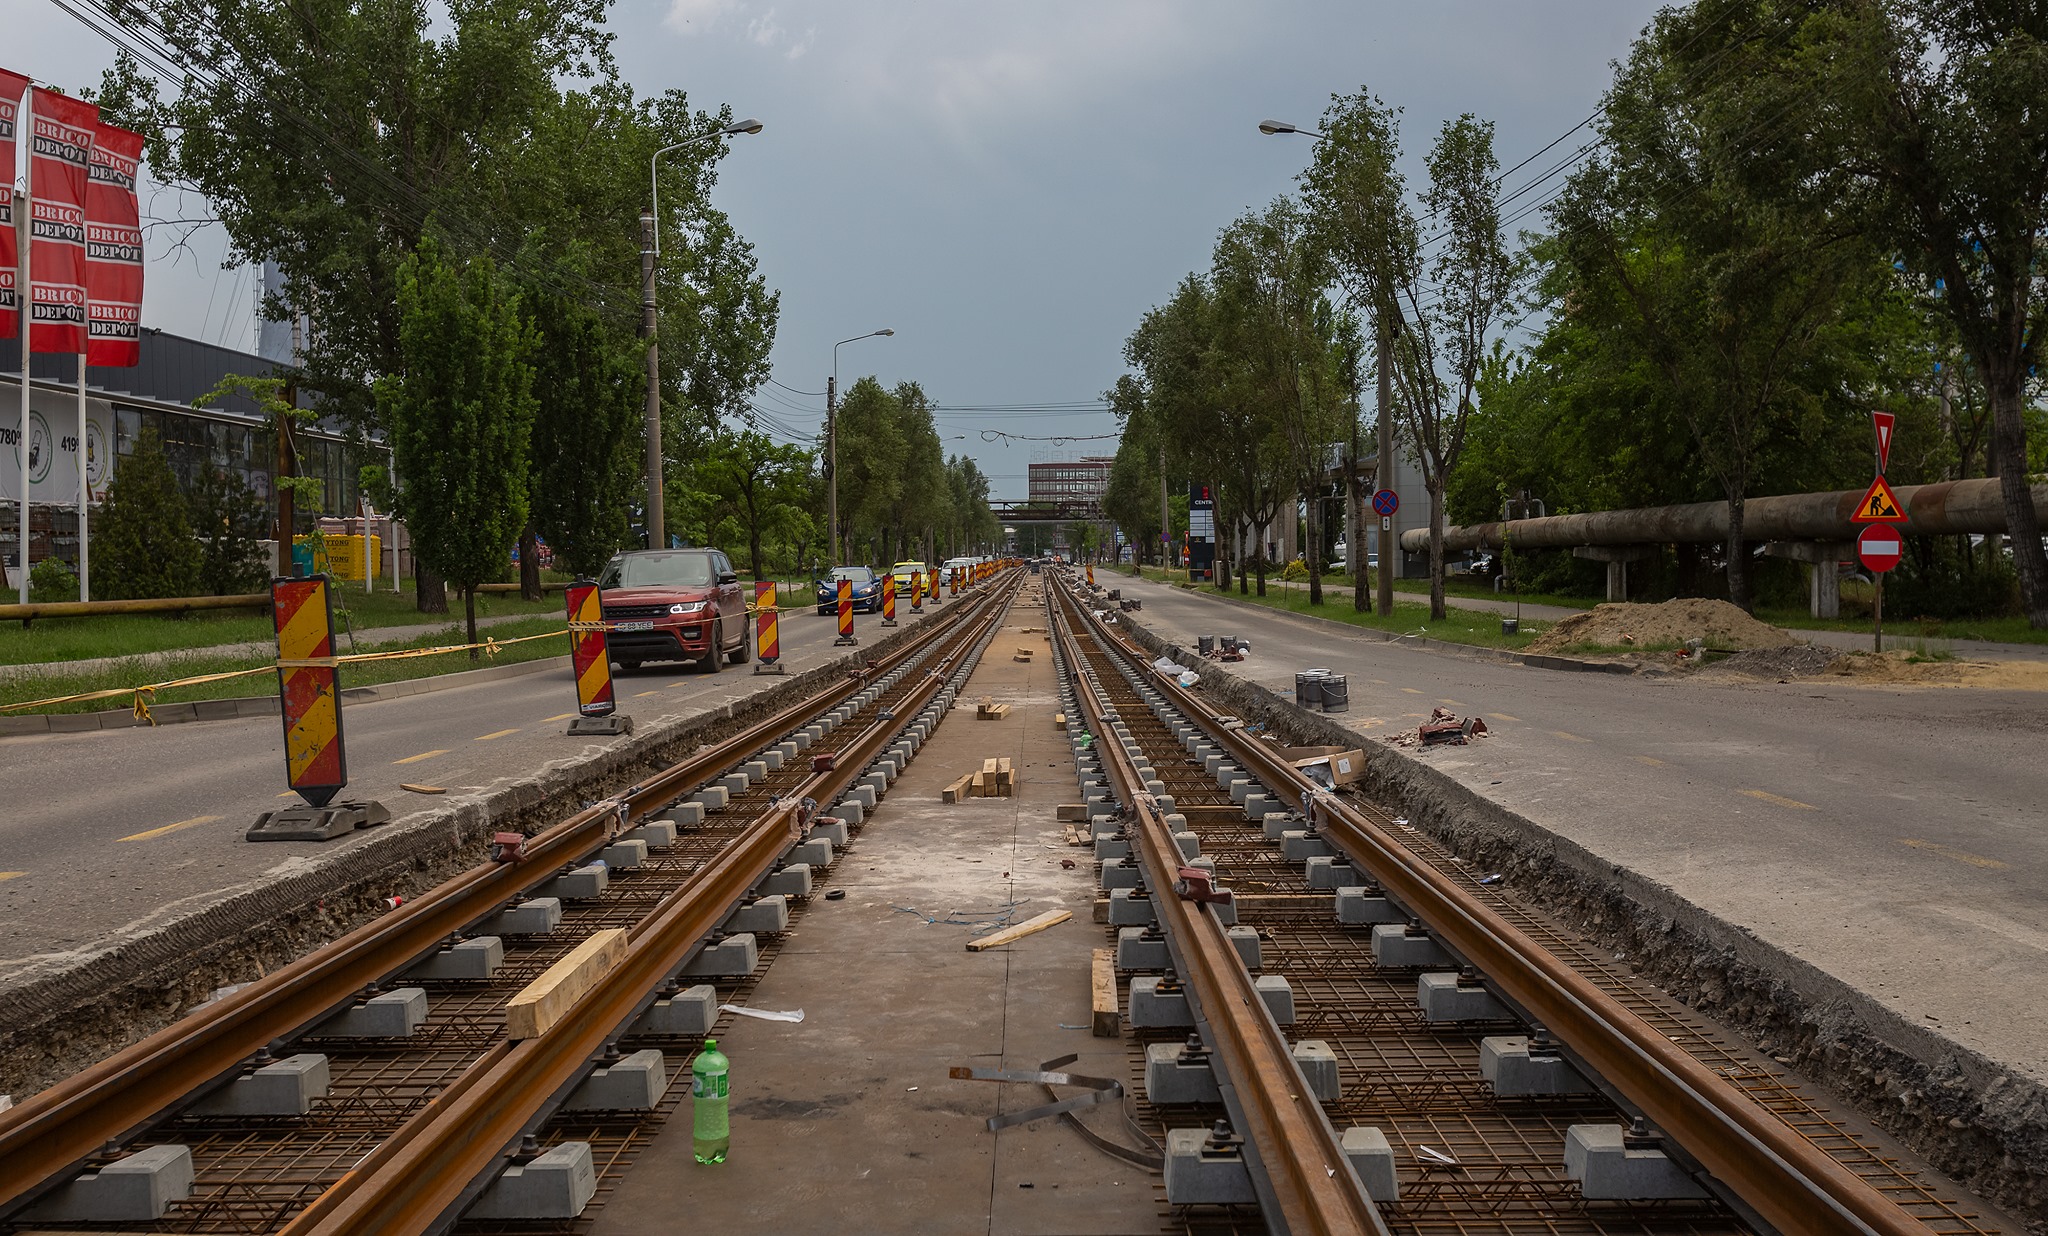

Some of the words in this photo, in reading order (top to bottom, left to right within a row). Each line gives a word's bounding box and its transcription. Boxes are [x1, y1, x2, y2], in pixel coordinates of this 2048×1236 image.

[36, 120, 88, 147] BRICO
[90, 149, 134, 175] BRICO
[34, 204, 83, 225] BRICO
[90, 227, 140, 244] BRICO
[91, 305, 137, 320] BRICO
